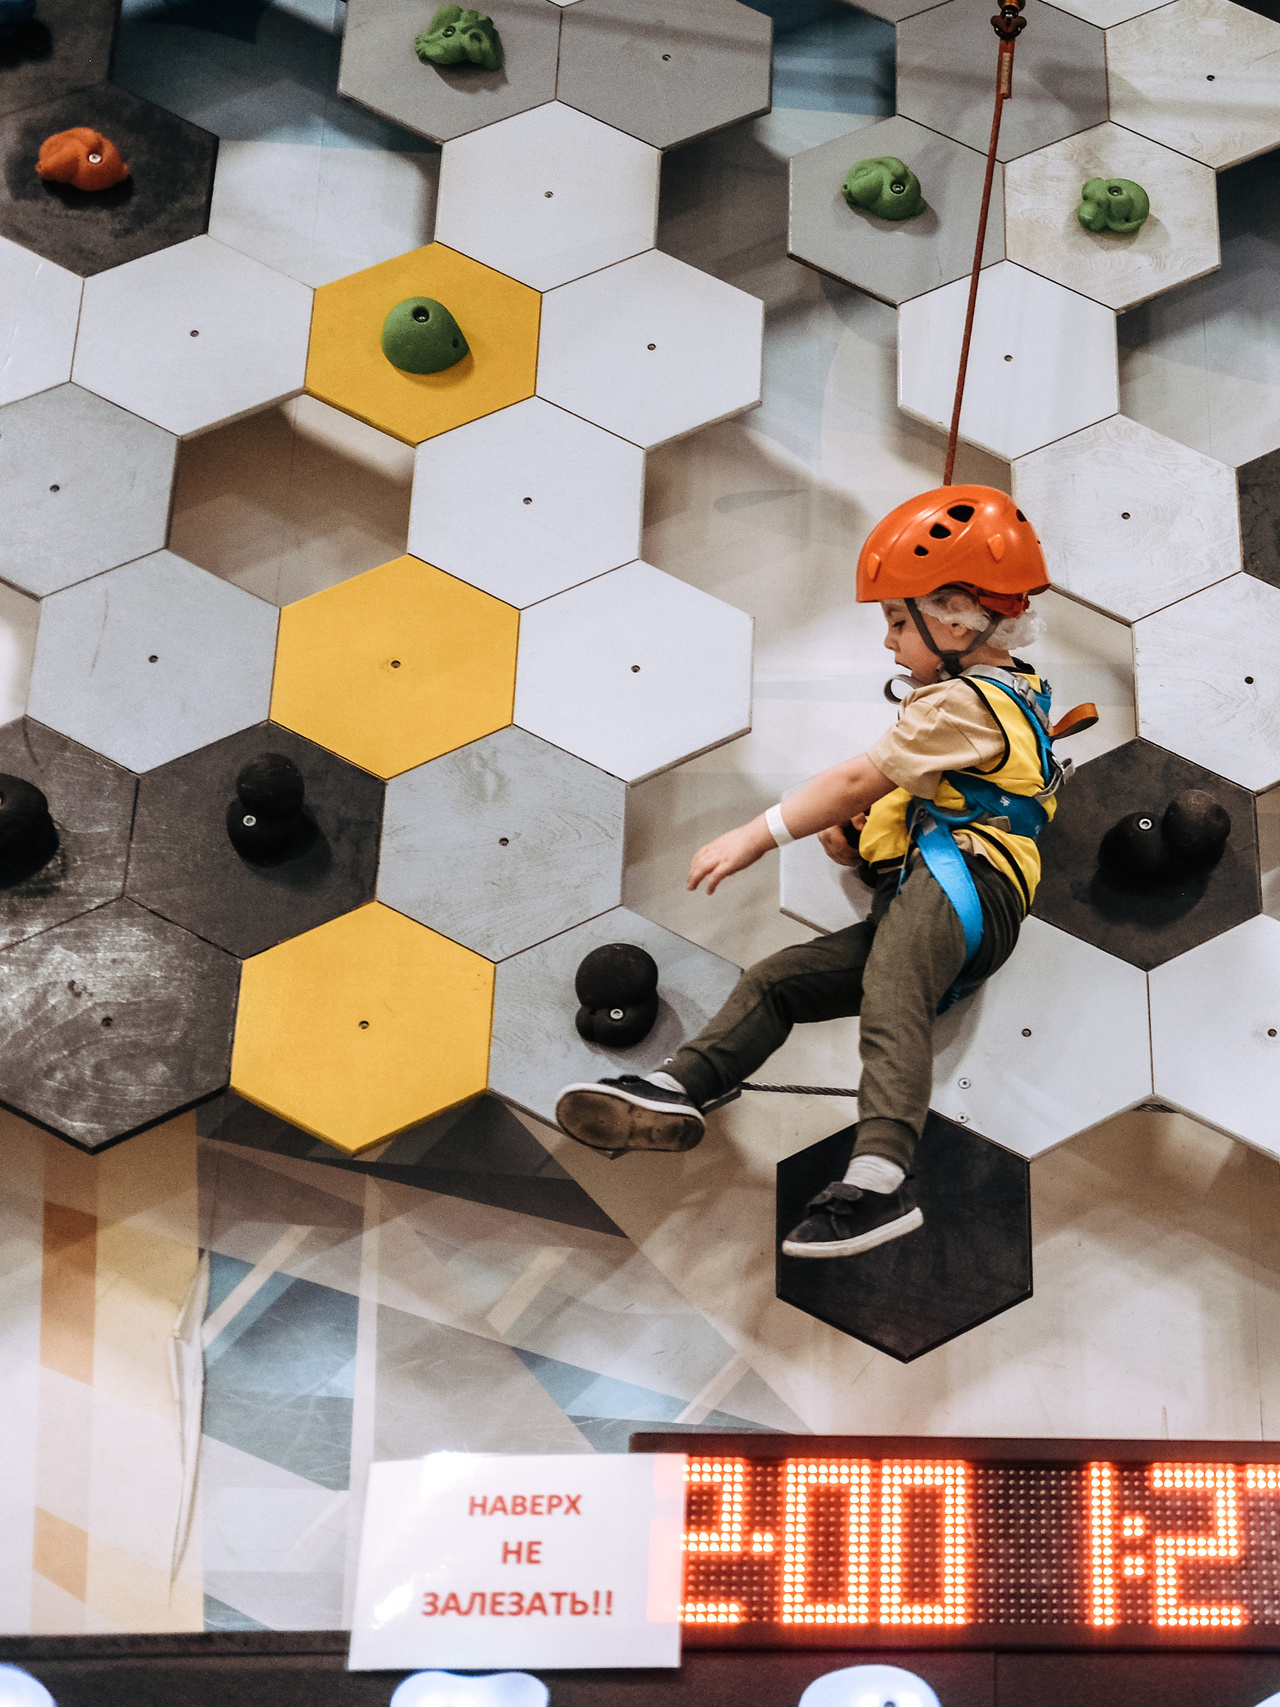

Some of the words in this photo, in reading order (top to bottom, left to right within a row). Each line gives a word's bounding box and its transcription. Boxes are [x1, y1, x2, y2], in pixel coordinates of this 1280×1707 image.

[468, 1494, 582, 1516] НАВЕРХ
[501, 1540, 543, 1565] НЕ
[422, 1590, 613, 1617] ЗАЛЕЗАТЬ!!
